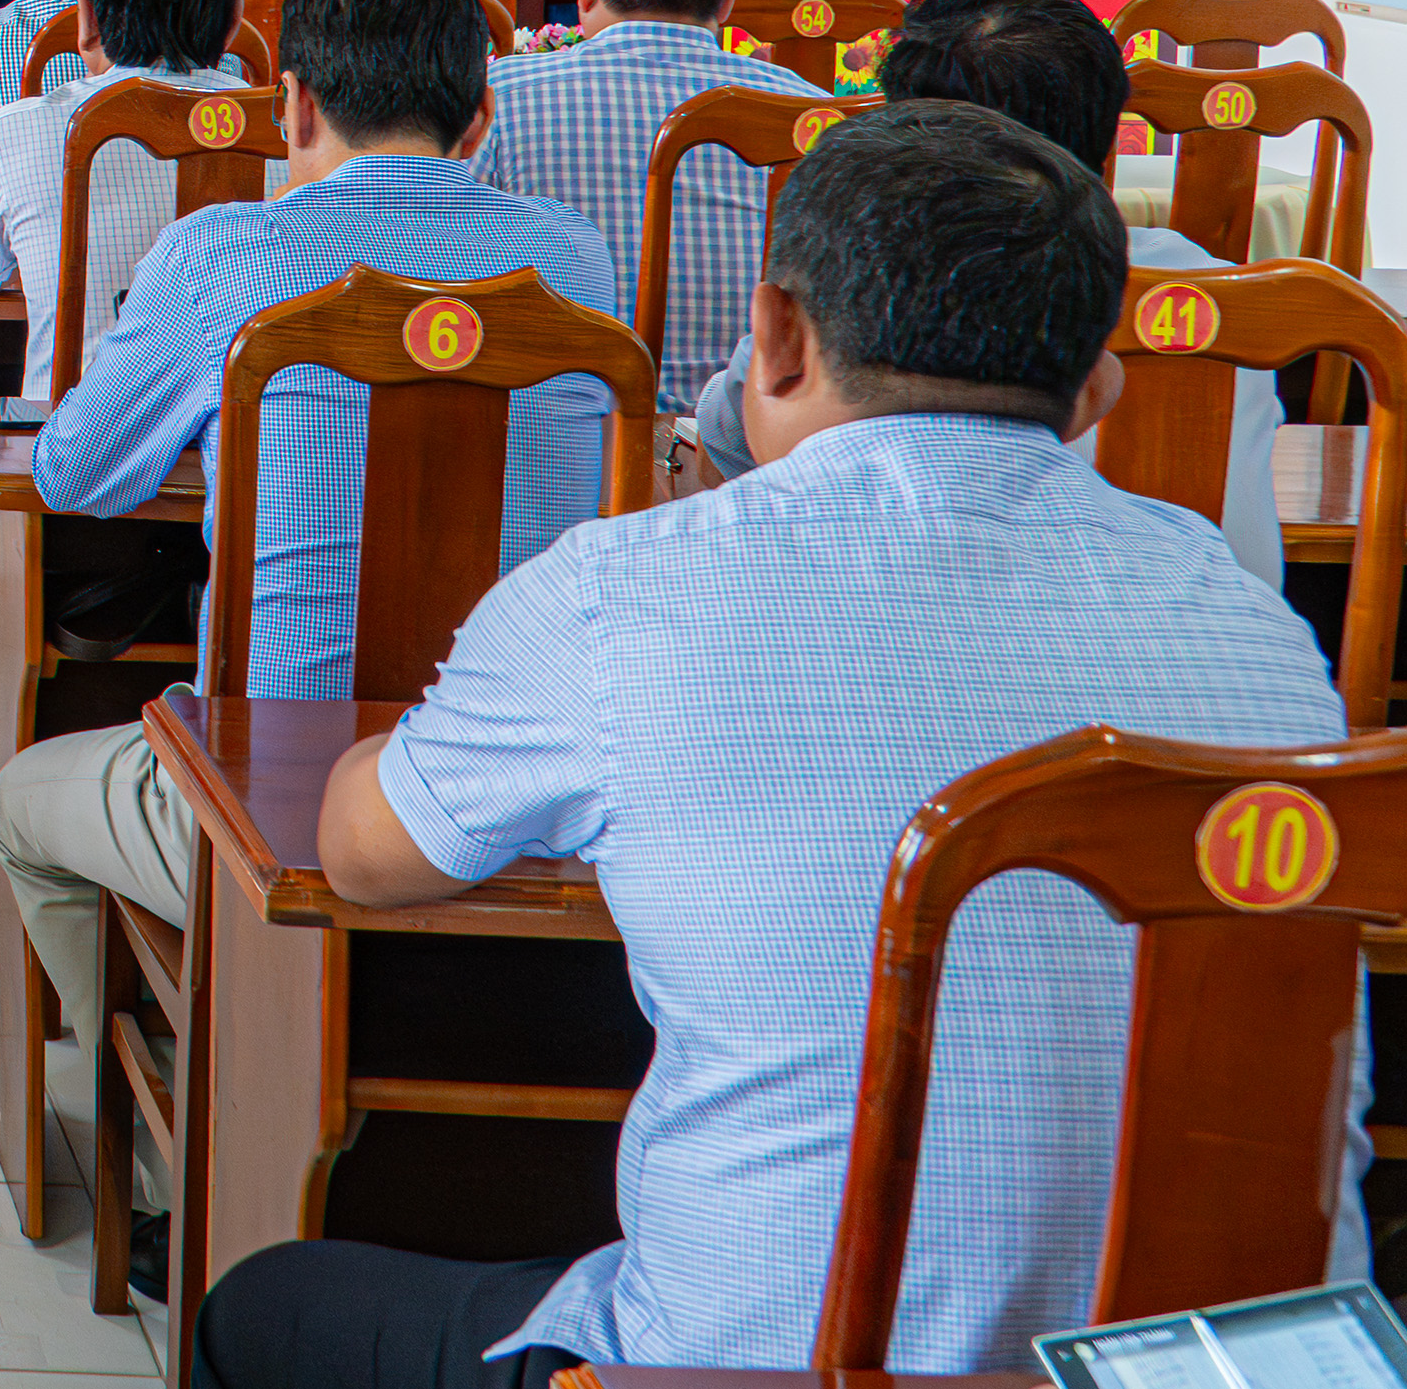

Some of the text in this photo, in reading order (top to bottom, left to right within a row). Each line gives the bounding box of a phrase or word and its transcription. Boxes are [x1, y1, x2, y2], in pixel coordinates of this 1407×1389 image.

[799, 5, 827, 31] 54
[199, 103, 236, 141] 93
[1215, 90, 1246, 123] 50
[428, 311, 459, 359] 6
[1150, 296, 1198, 344] 41
[1226, 804, 1307, 893] 10
